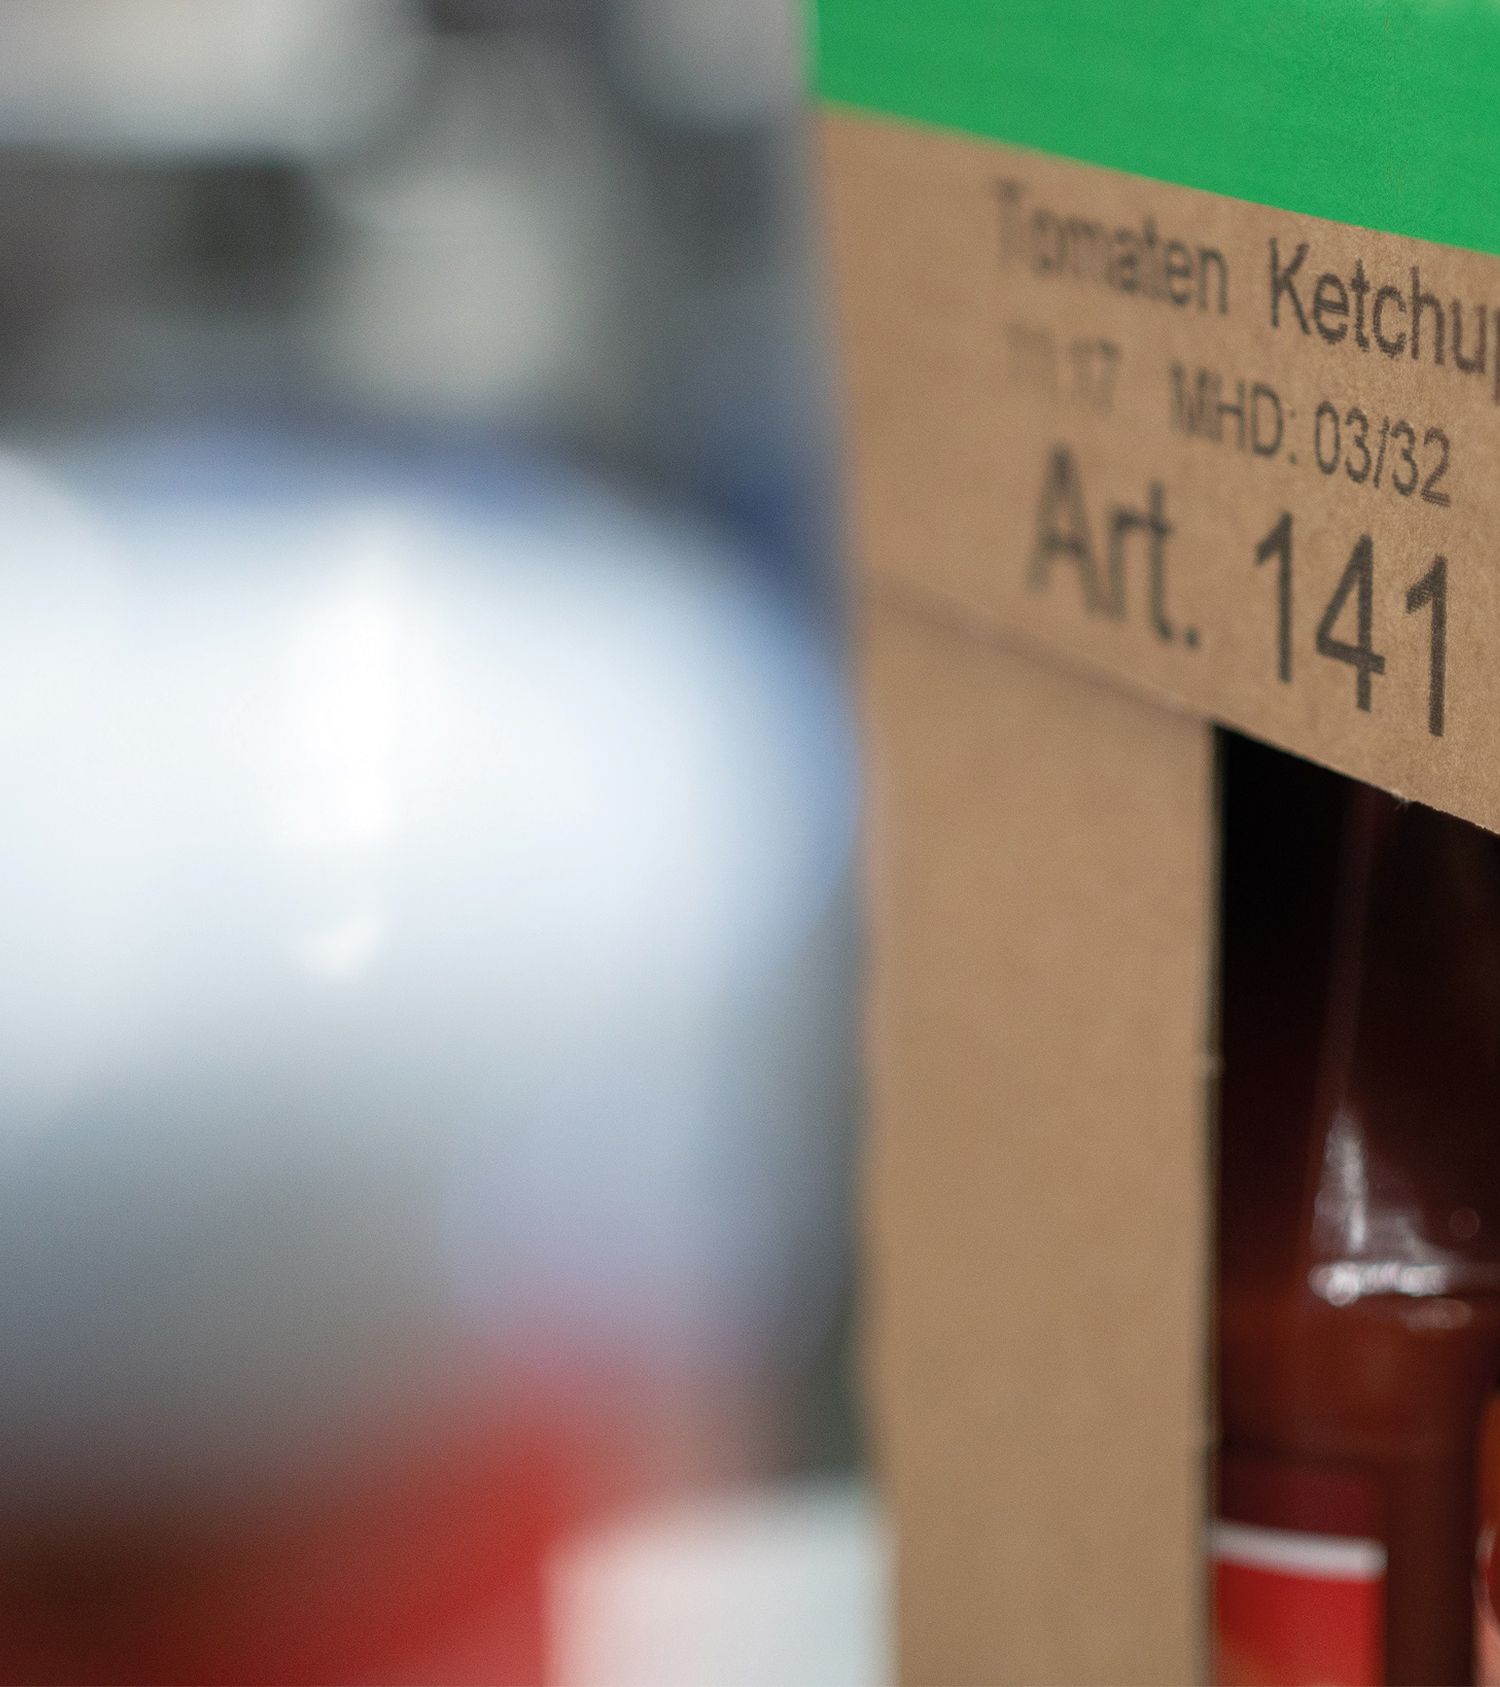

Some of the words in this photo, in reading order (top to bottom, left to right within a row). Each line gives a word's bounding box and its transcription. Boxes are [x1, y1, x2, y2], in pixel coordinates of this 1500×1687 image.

[993, 178, 1229, 317] Tomaten
[1171, 360, 1300, 466] MHD:
[1313, 400, 1453, 508] 03/32
[1027, 441, 1202, 650] Art.
[1255, 510, 1449, 737] 141
